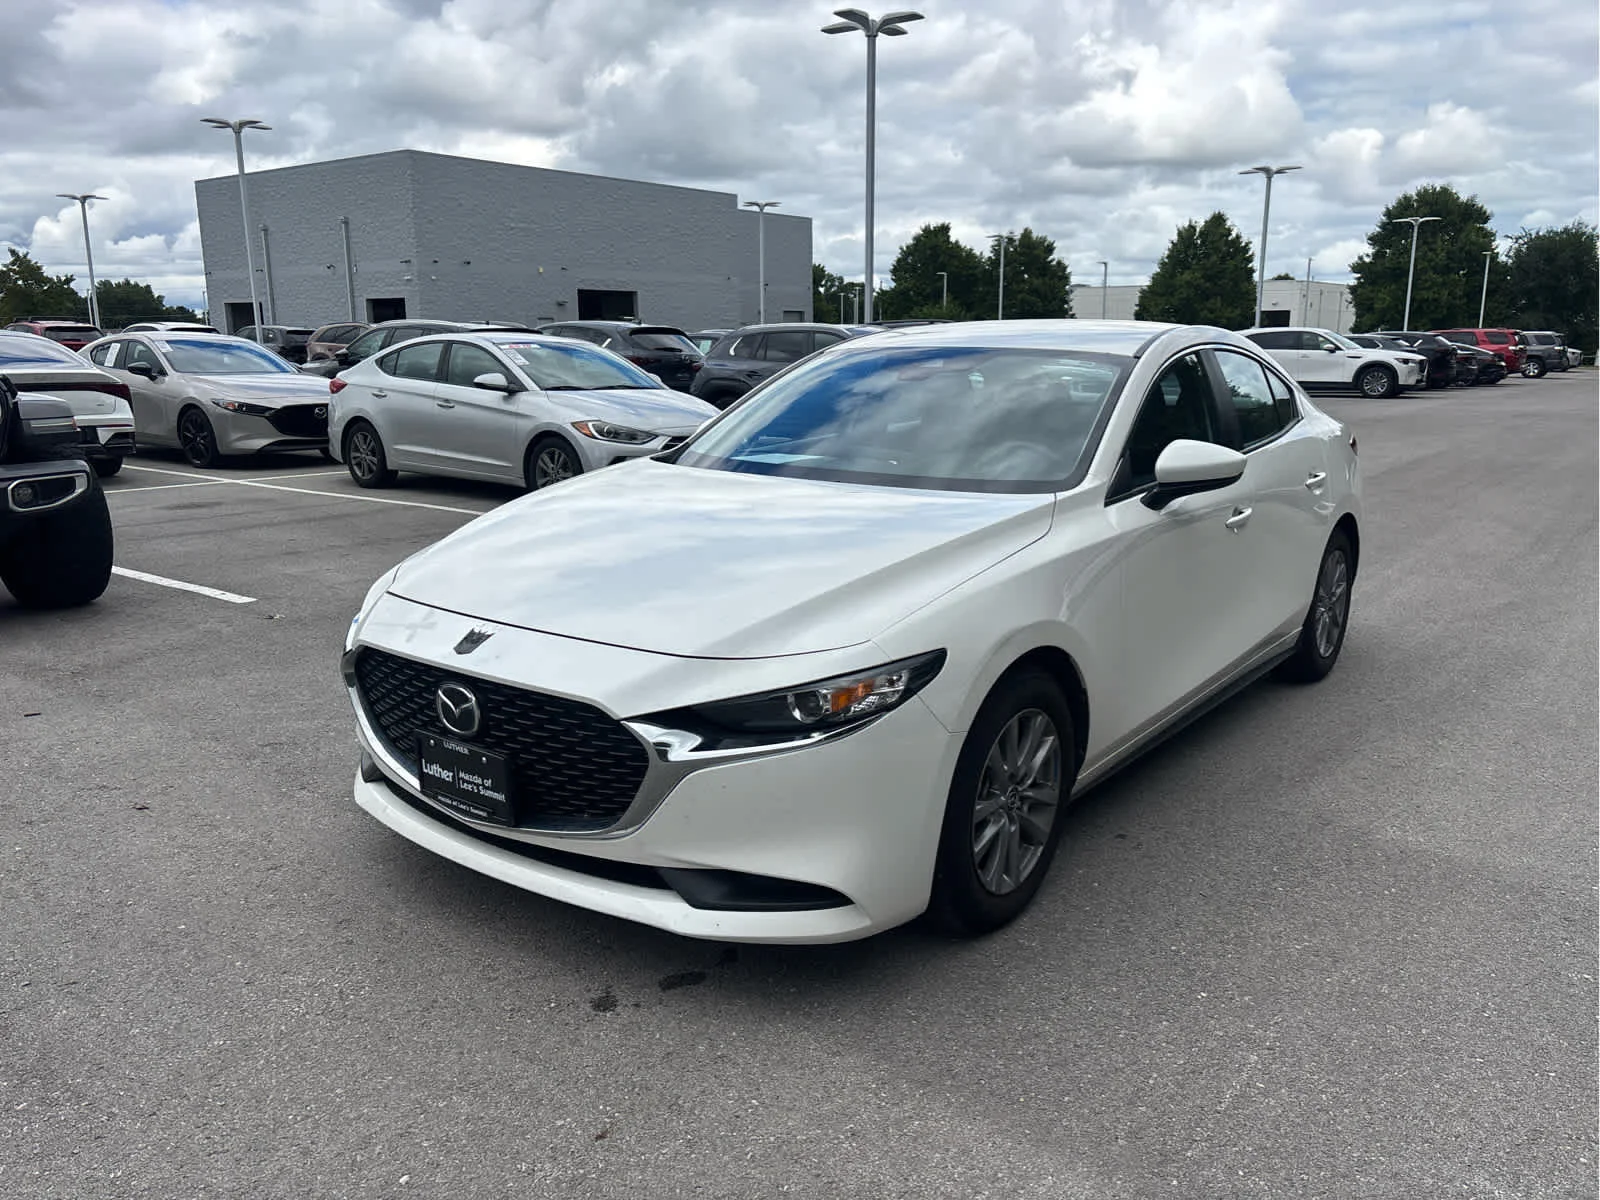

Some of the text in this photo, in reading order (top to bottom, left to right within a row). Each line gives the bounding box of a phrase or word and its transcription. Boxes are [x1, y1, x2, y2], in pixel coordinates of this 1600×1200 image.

[422, 758, 453, 782] Luther
[459, 770, 492, 787] Mazda of
[460, 780, 506, 802] Lee's Summit
